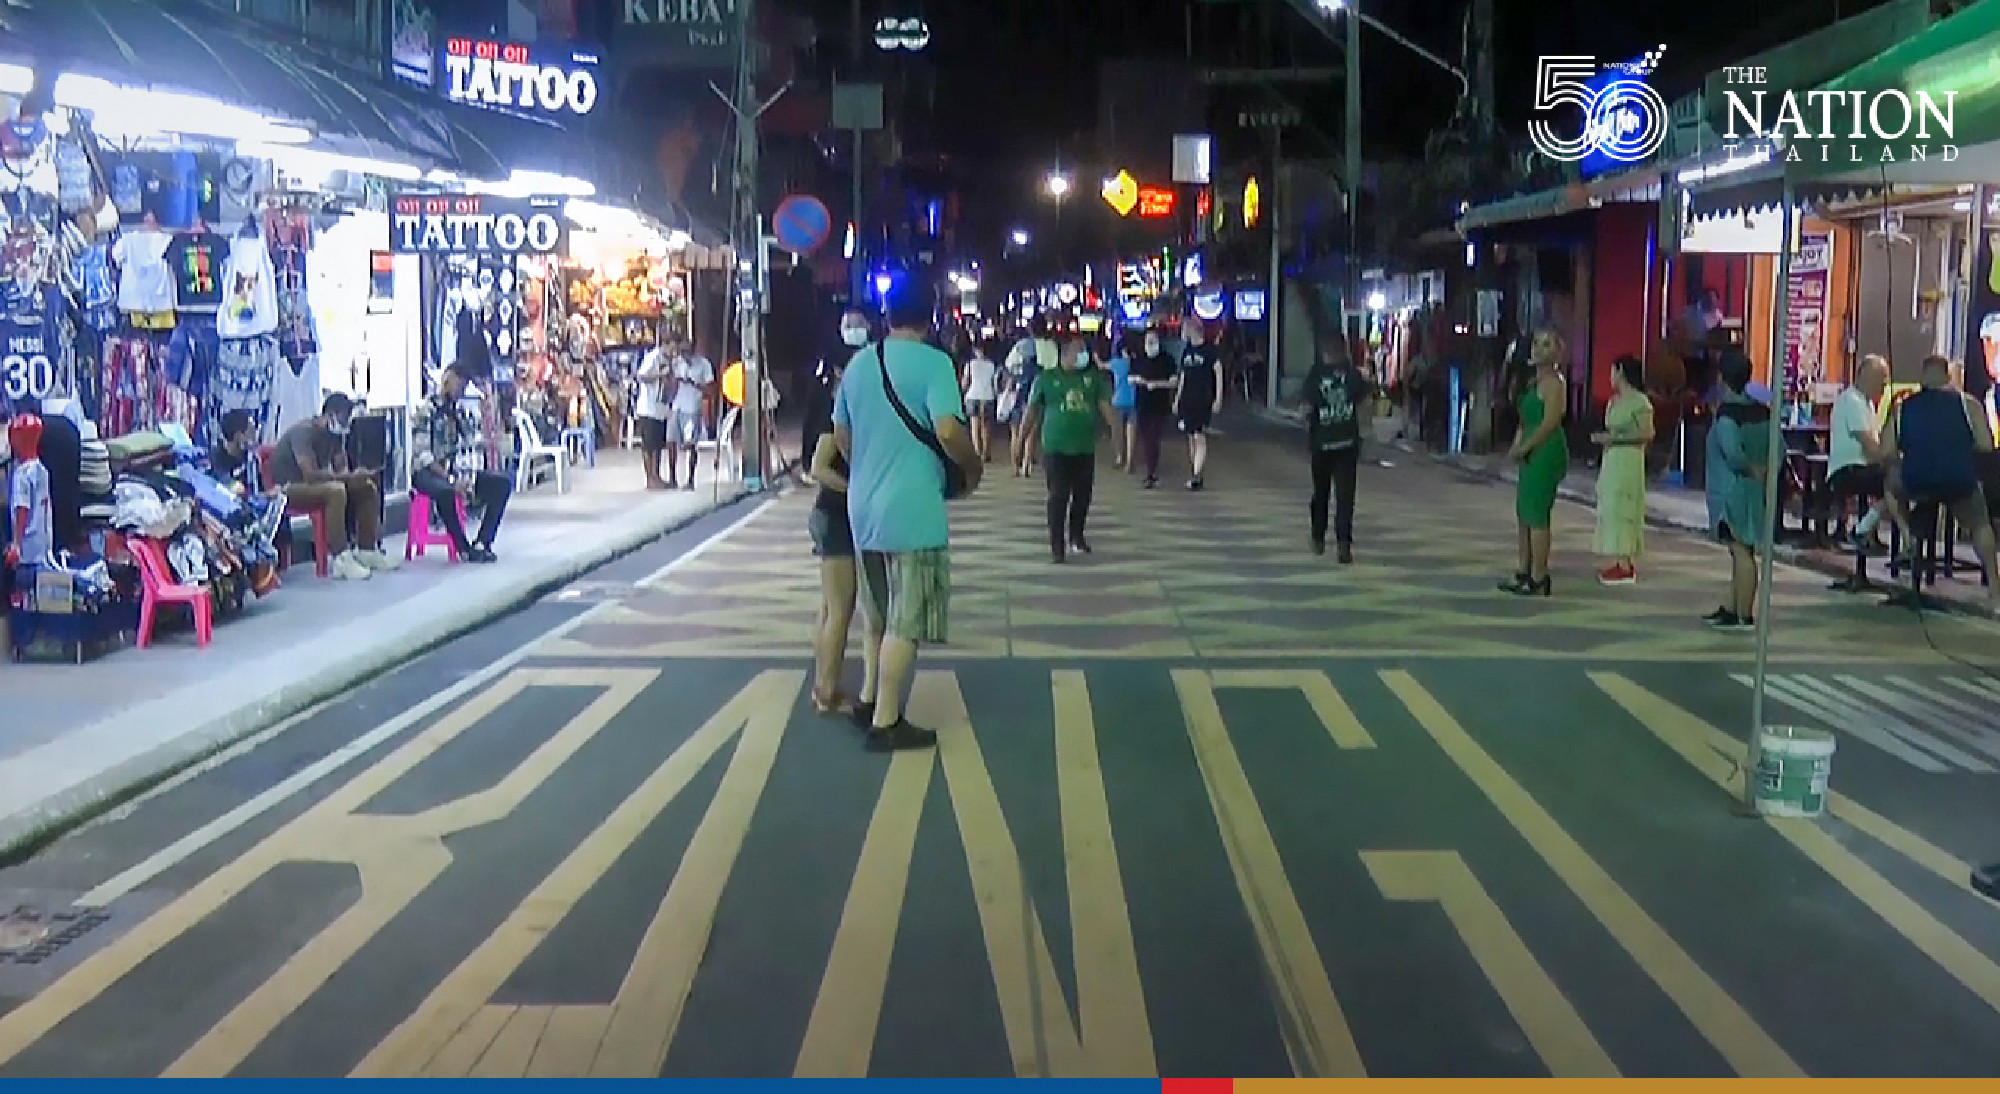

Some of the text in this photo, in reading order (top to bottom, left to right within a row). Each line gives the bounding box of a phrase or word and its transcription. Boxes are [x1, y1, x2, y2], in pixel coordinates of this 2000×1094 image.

[446, 54, 597, 113] TATTOO
[394, 214, 559, 250] TATTOO
[4, 355, 53, 398] 30
